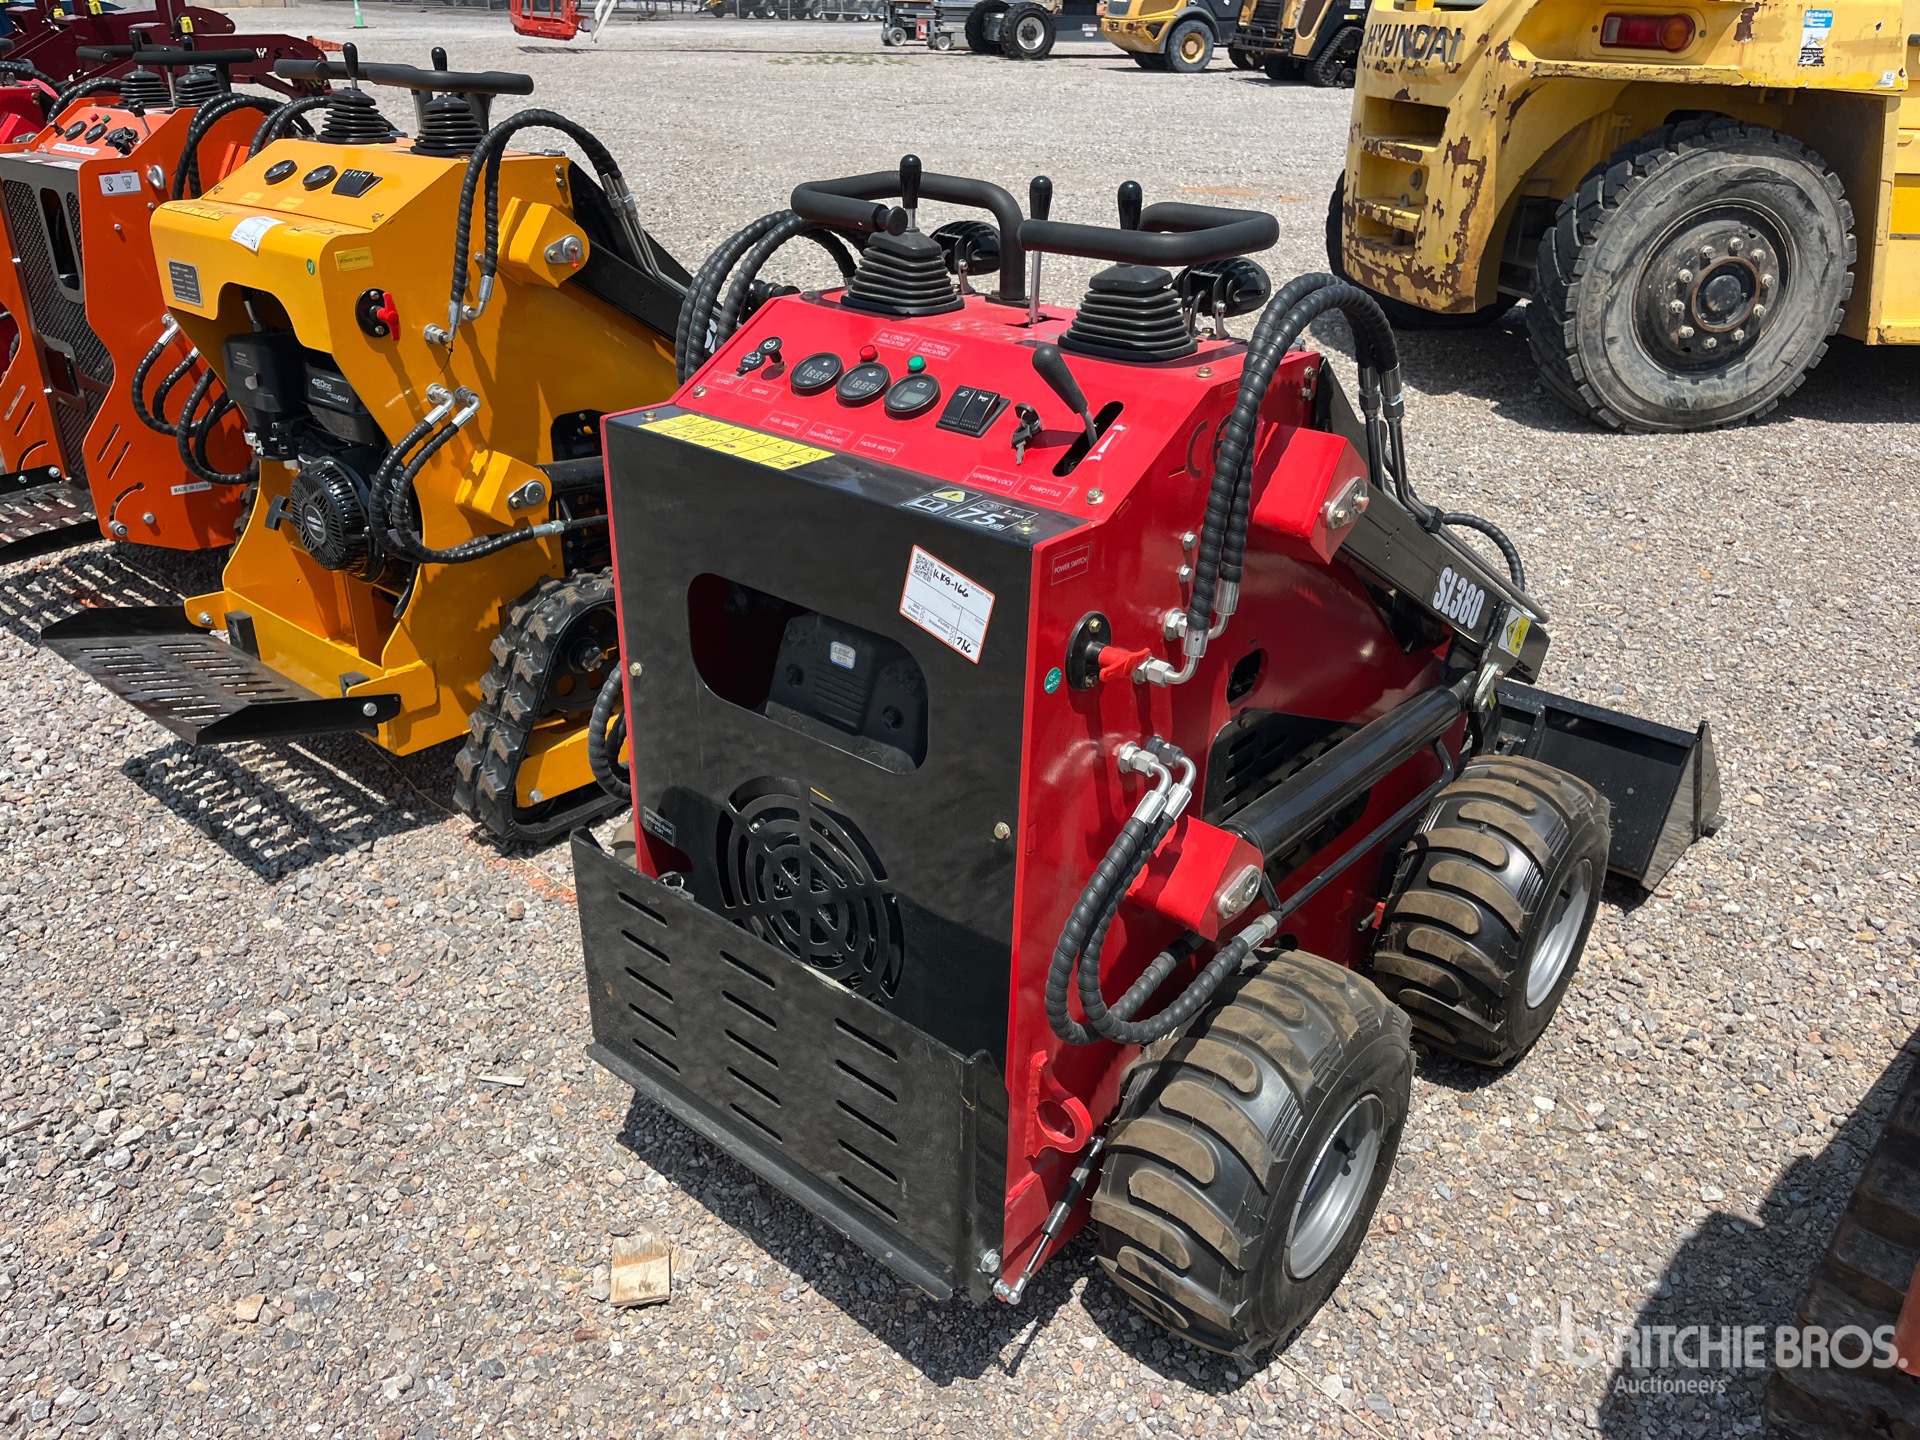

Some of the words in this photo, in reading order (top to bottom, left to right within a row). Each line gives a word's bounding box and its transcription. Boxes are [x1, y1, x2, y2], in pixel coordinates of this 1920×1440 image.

[1368, 24, 1461, 63] HYUNDAI
[878, 338, 905, 347] INDICATOR
[918, 347, 947, 356] INDICATOR
[312, 378, 332, 390] 420cc
[769, 417, 781, 425] FUEL
[781, 420, 799, 429] GAUGE
[860, 440, 877, 449] HOUR
[877, 444, 896, 453] METER
[972, 472, 998, 483] IGNITION
[997, 479, 1014, 487] LOCK
[1029, 484, 1062, 497] THROTTLE
[955, 508, 1006, 525] 75
[1054, 562, 1070, 574] POWER
[1070, 555, 1088, 568] SWITCH
[1433, 567, 1485, 630] SL380
